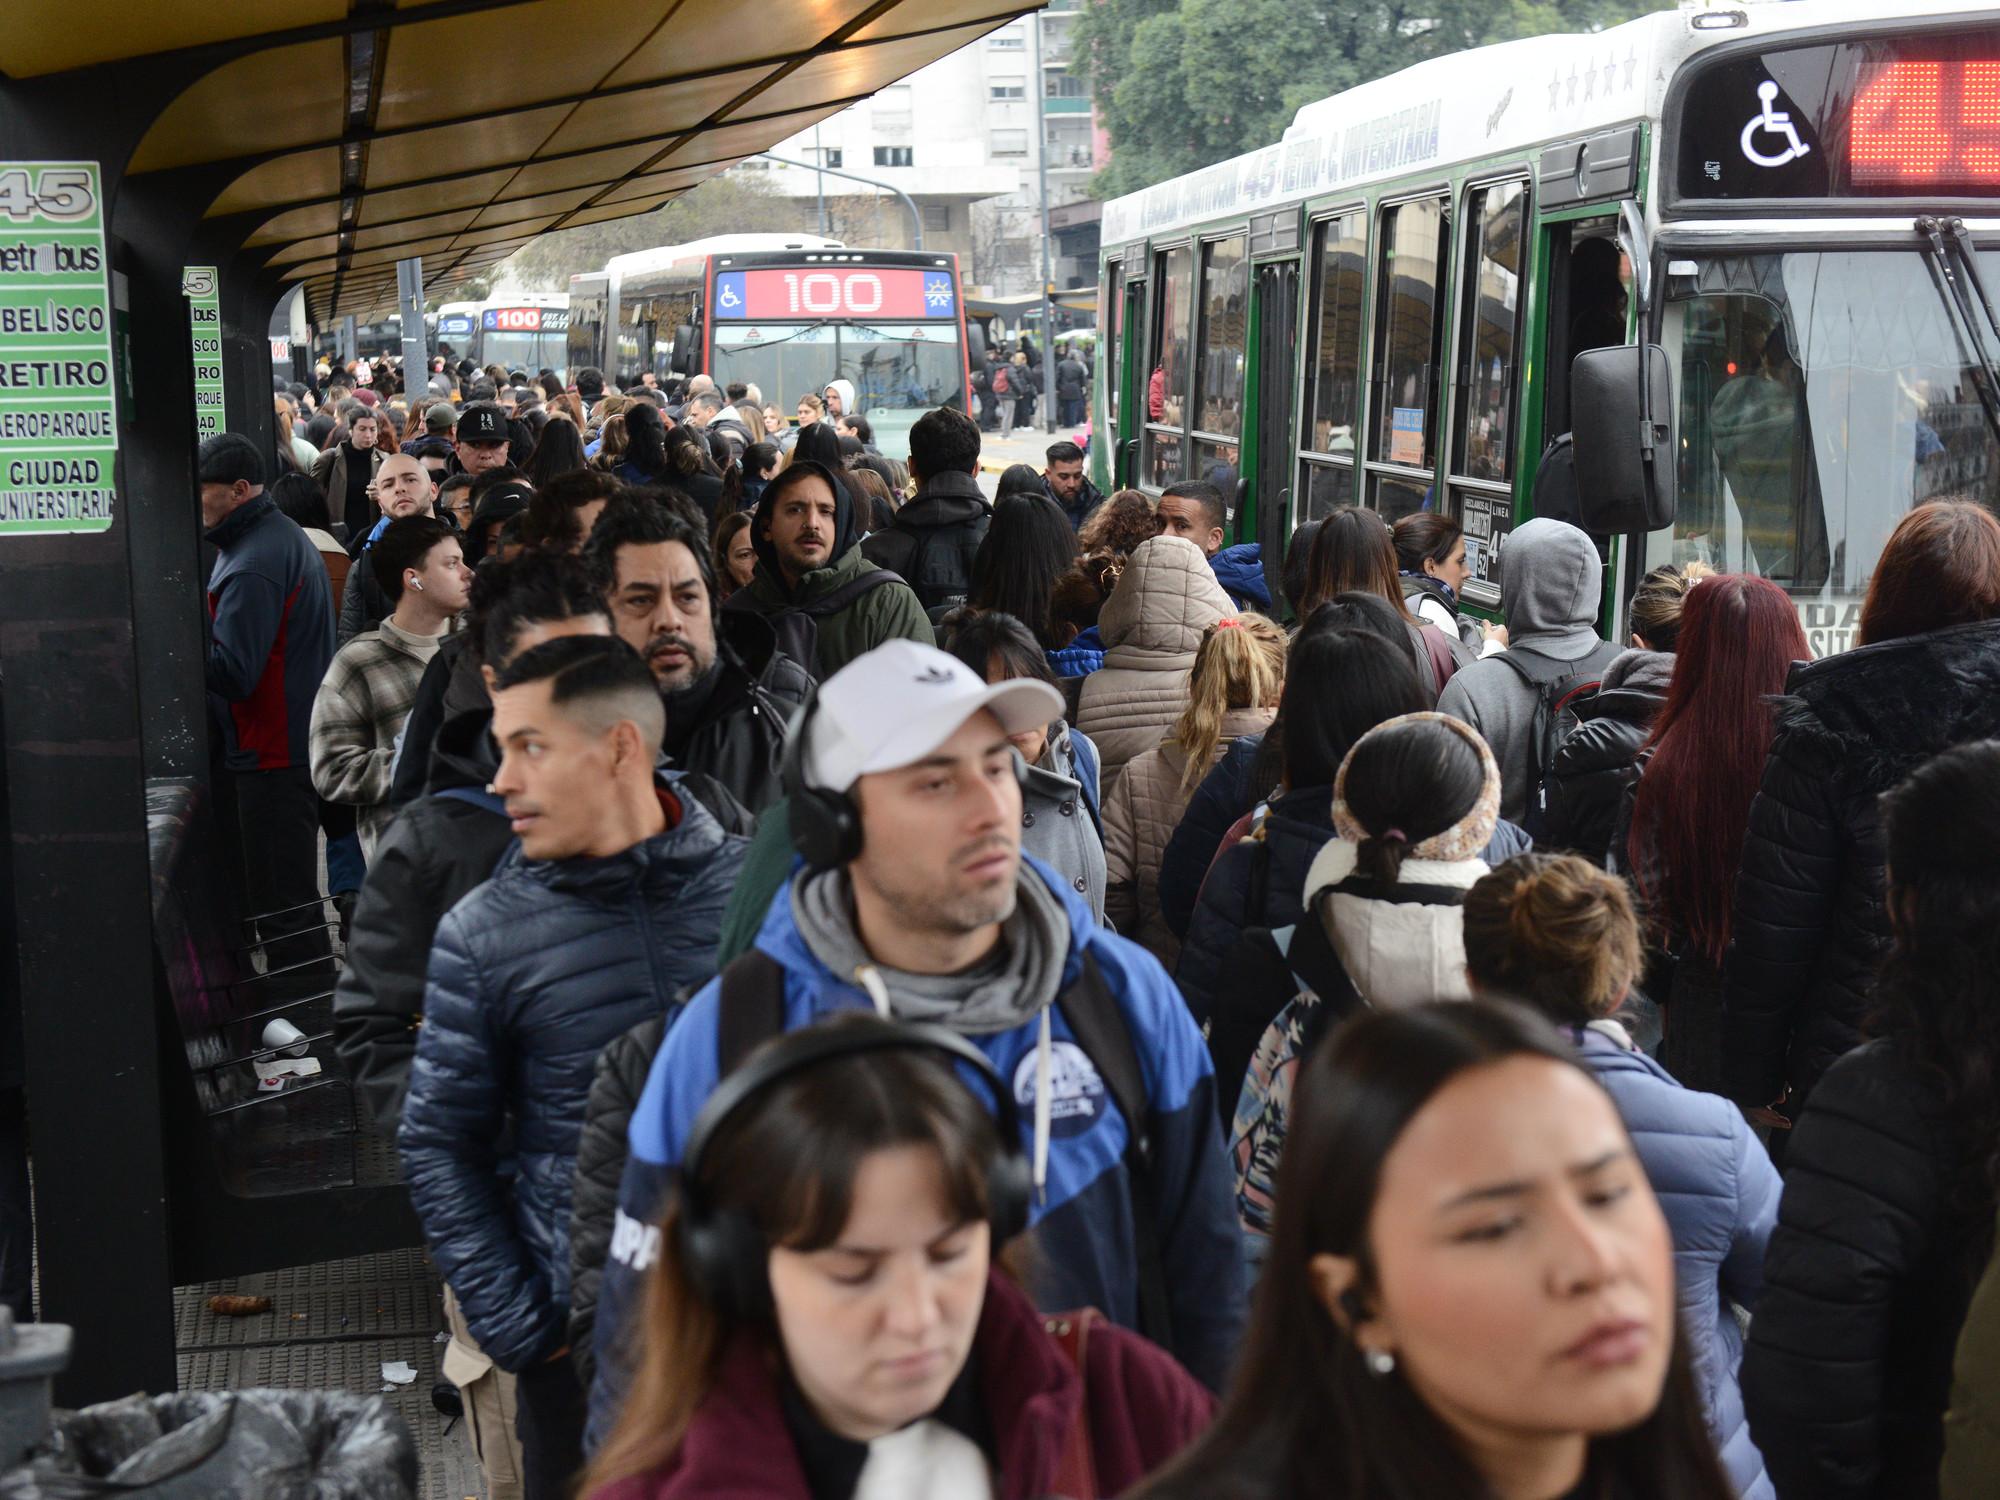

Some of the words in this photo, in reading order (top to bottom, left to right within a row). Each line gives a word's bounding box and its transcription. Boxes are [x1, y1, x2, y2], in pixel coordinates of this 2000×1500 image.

[0, 172, 93, 216] 45
[184, 271, 214, 294] 5
[784, 273, 883, 312] 100
[497, 311, 539, 328] 100
[0, 411, 112, 437] EROPARQUE
[198, 416, 215, 429] AD
[10, 460, 99, 486] CIUDAD
[1493, 505, 1509, 518] LINEA
[1477, 553, 1487, 576] 52
